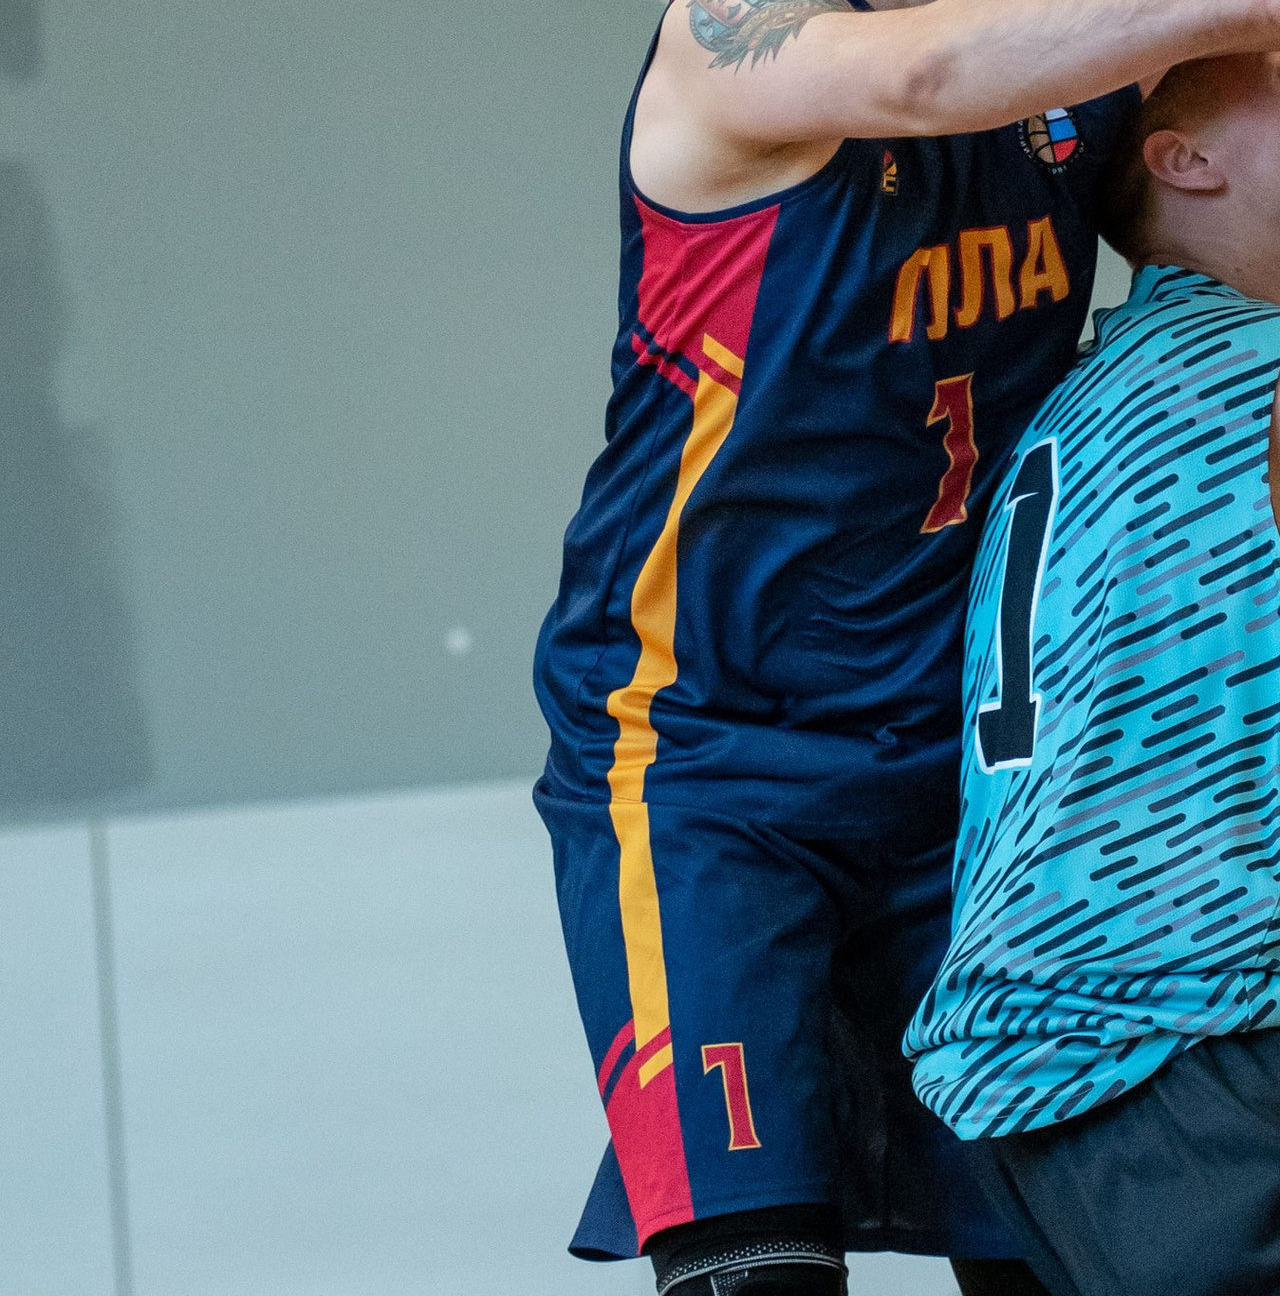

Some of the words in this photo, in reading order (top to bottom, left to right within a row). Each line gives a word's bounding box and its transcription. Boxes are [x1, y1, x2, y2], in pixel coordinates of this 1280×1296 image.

[920, 372, 979, 535] 1
[978, 436, 1059, 774] 1
[701, 1042, 761, 1151] 1
